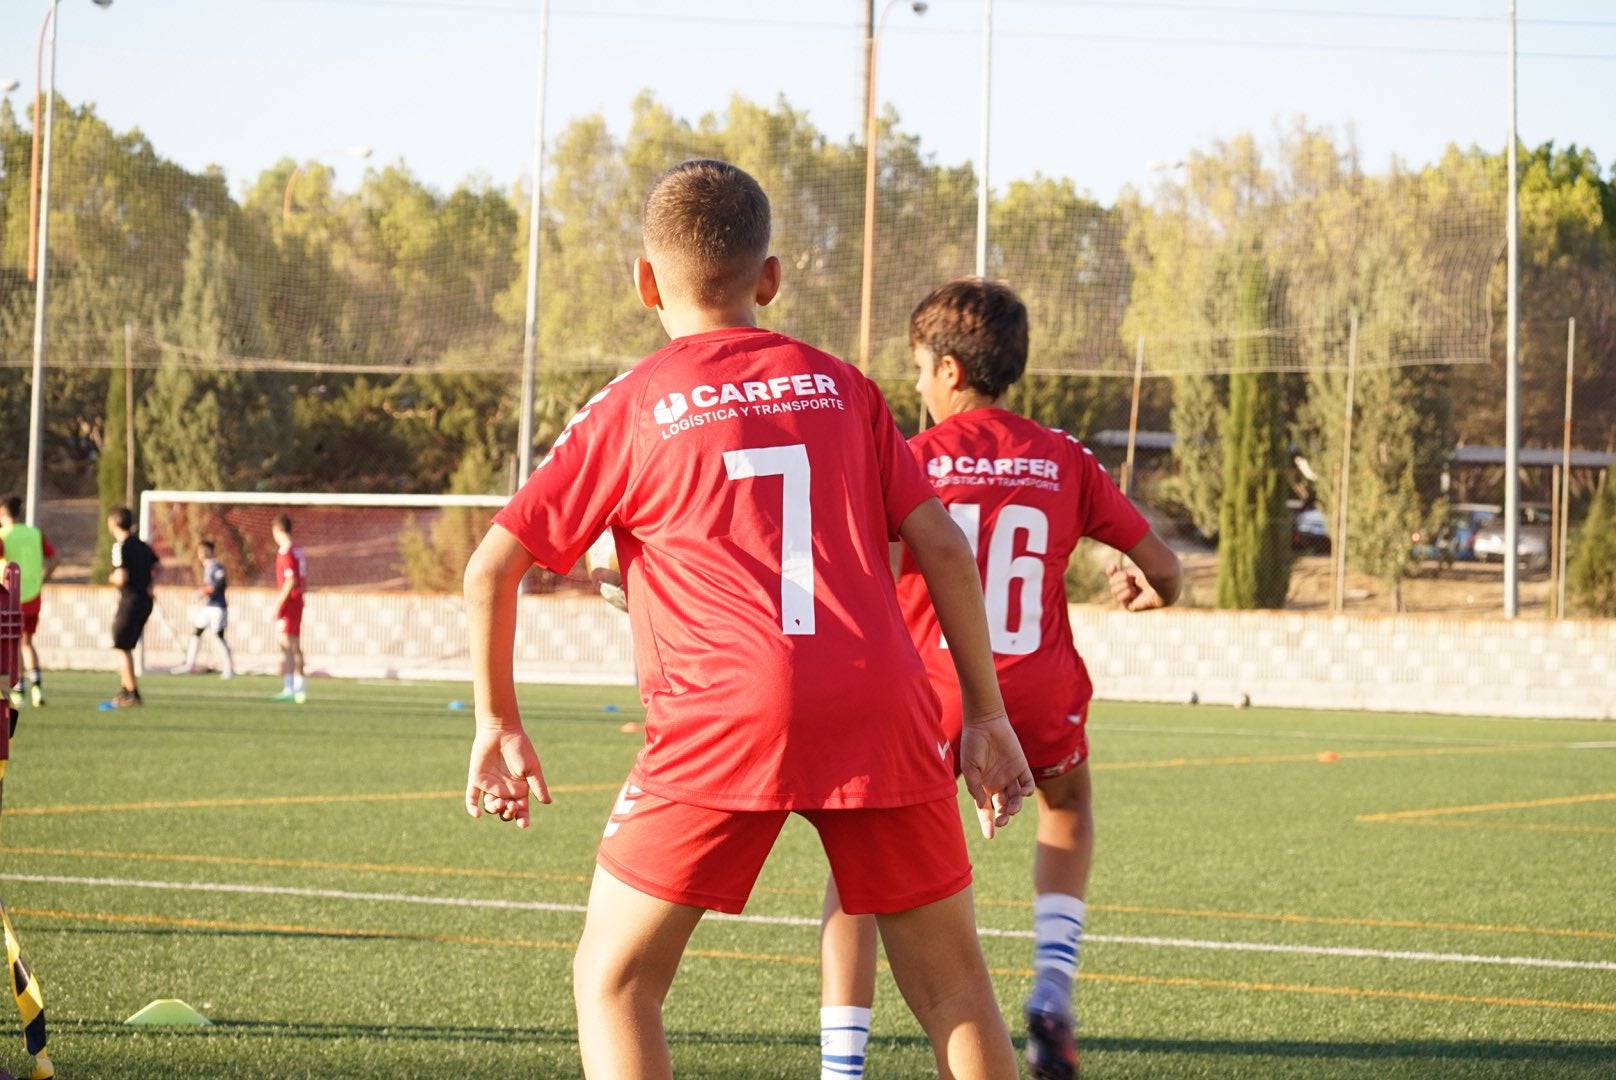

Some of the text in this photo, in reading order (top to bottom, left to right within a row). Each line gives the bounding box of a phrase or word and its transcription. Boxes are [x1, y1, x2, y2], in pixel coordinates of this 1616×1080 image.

[691, 374, 839, 408] CARFER
[661, 397, 844, 440] LOGÍSTICA Y TRANSPORTE
[955, 456, 1058, 480] CARFER
[987, 476, 995, 485] Y
[998, 477, 1060, 492] TRANSPORTE
[722, 443, 815, 635] 7
